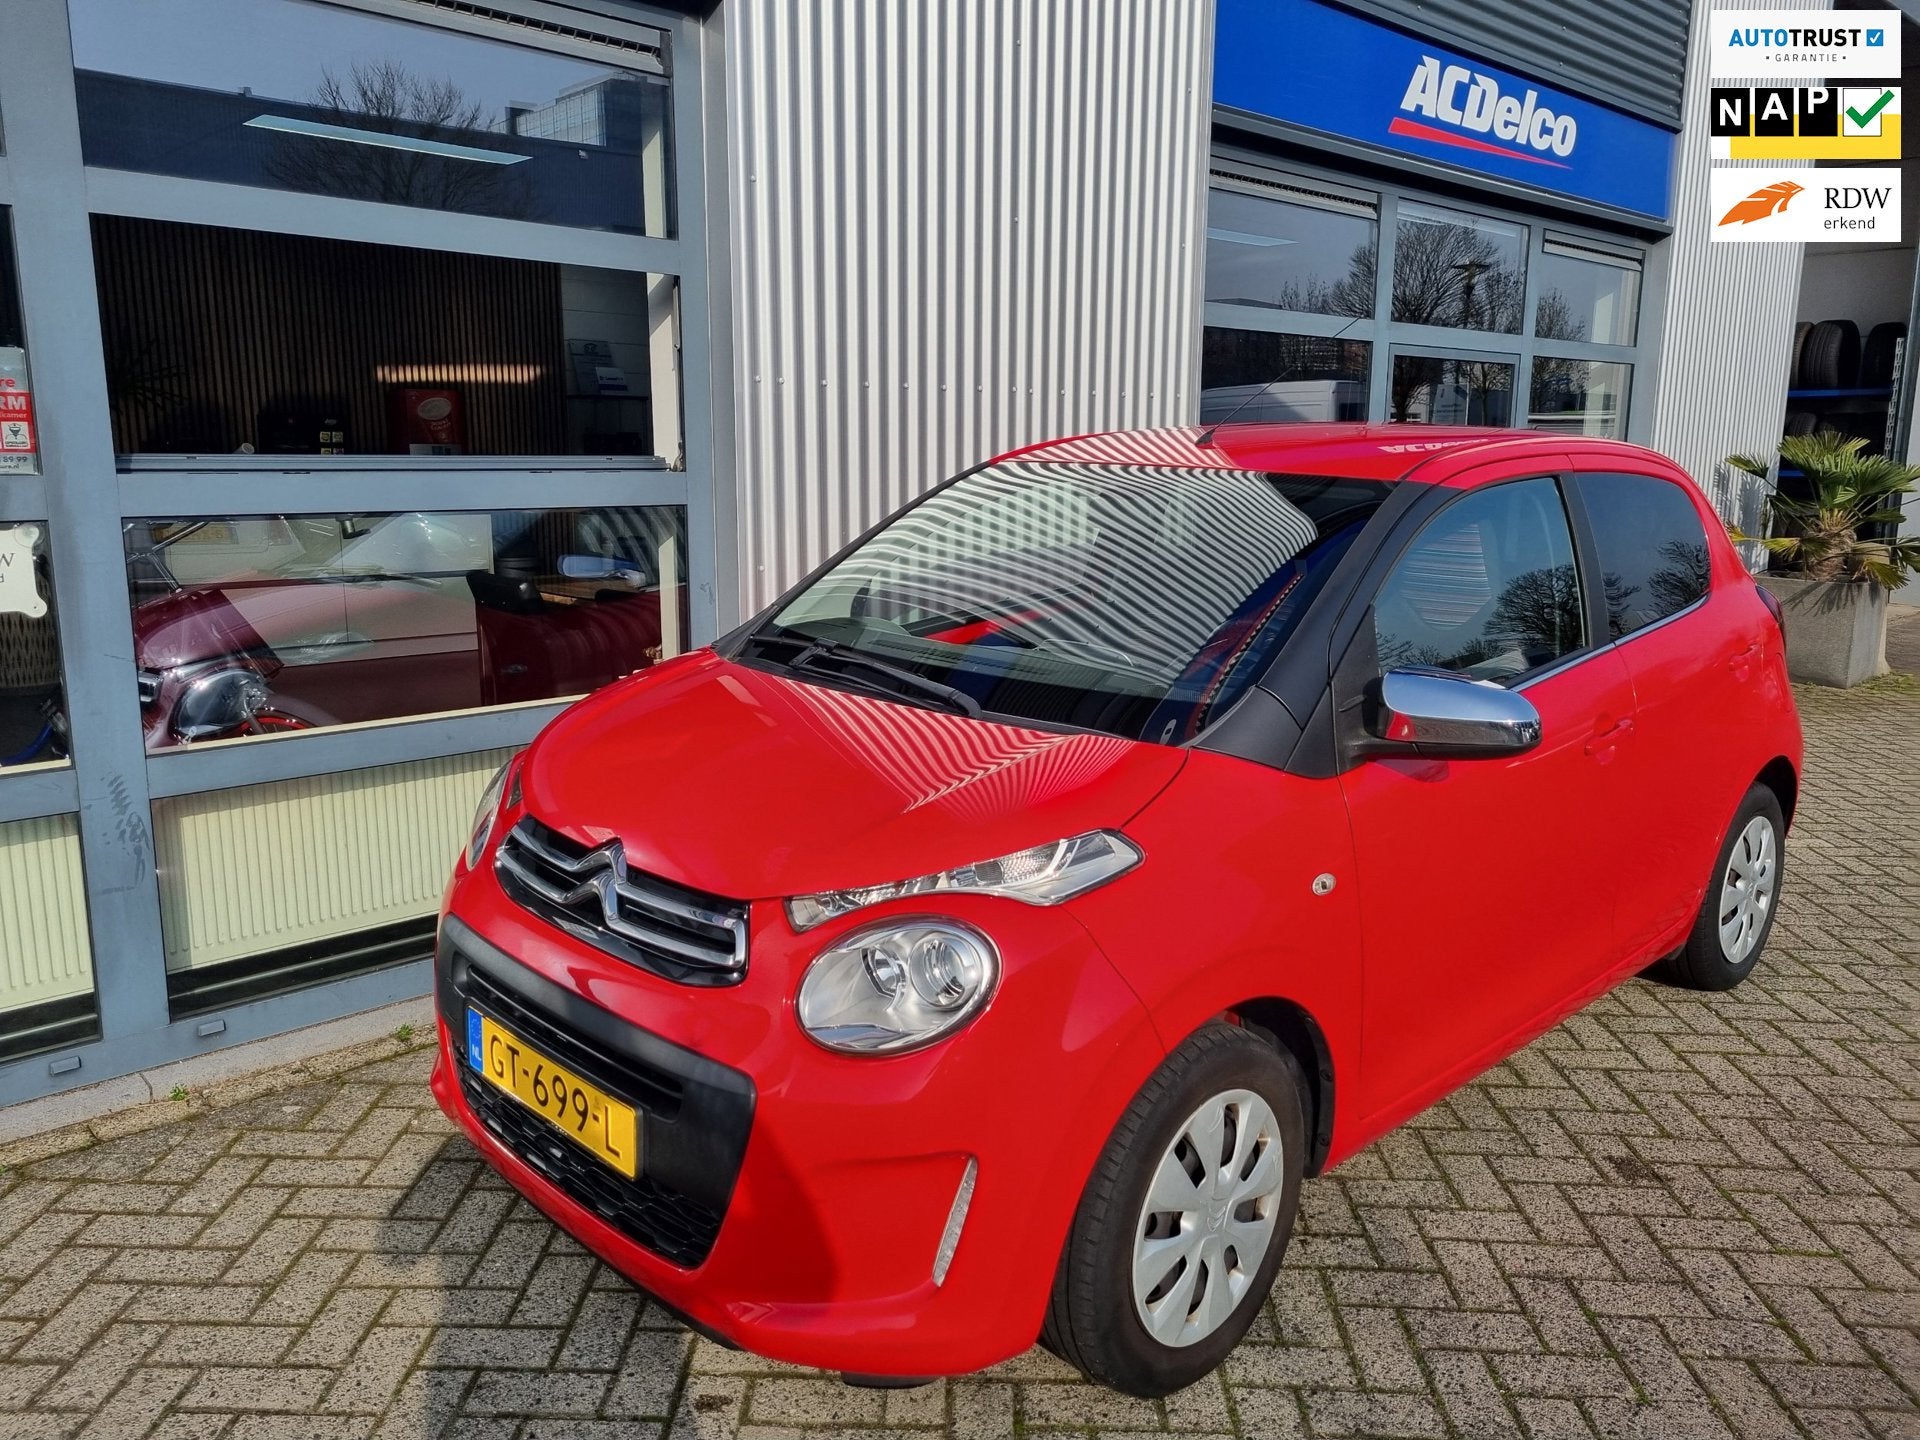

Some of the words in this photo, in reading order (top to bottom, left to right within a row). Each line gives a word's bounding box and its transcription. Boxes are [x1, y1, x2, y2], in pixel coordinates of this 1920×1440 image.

[1400, 55, 1577, 157] ACDelco
[471, 1043, 482, 1061] NL
[489, 1033, 623, 1160] GT-699-L
